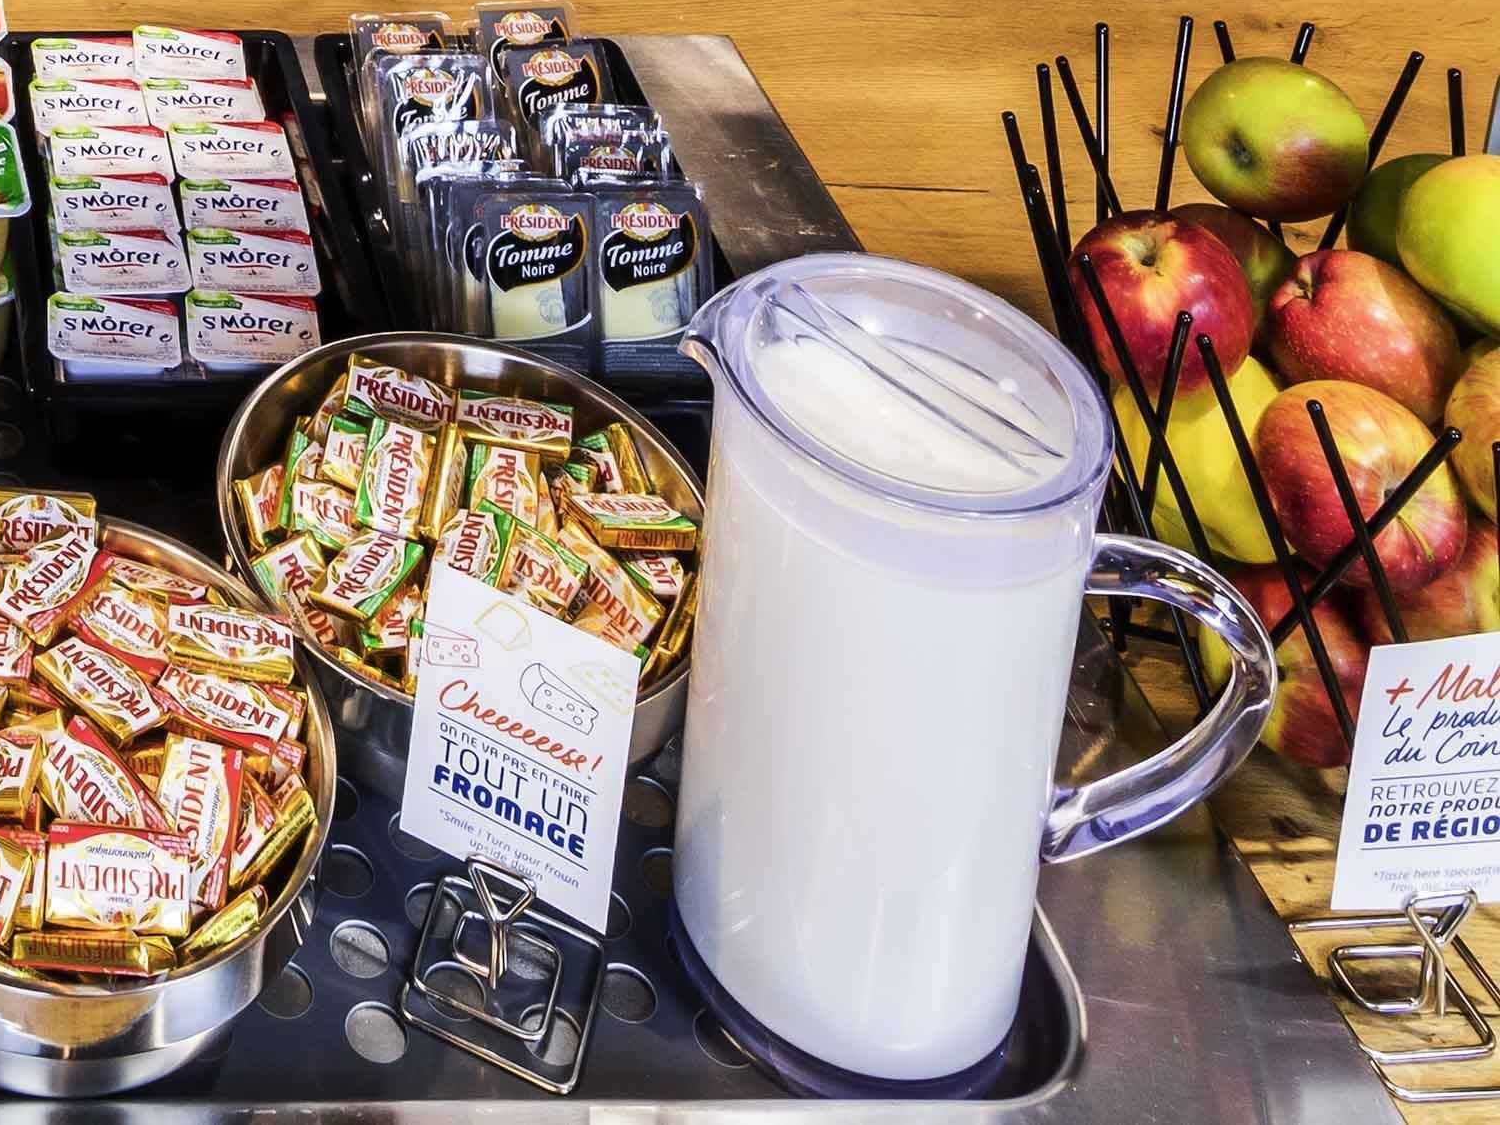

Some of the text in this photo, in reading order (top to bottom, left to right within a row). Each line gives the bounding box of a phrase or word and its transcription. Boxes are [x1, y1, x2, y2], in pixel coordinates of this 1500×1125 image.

[523, 58, 582, 75] PRÉSIDENT
[524, 82, 589, 114] Tomme
[501, 212, 570, 229] PRÉSIDENT
[612, 212, 680, 228] PRÉSIDENT
[496, 243, 573, 267] Tomme
[607, 241, 684, 267] Tomme
[633, 262, 667, 277] Noire
[522, 264, 555, 277] Noire
[356, 375, 452, 422] PRÉSIDENT
[465, 404, 571, 433] PRÉSIDENT
[6, 538, 88, 611] PRÉSIDENT
[179, 612, 291, 649] PRÉSIDENT
[59, 642, 150, 719] PRÉSIDENT
[1417, 663, 1500, 709] Mal
[165, 667, 279, 728] PRÉSIDENT
[1424, 700, 1500, 740] produ
[440, 722, 590, 806] ON NE VA PAS EN FAIRE
[1384, 737, 1426, 765] du
[440, 735, 587, 834] TOUT UN
[1371, 778, 1499, 801] RETROUVEZ
[434, 764, 585, 859] FROMAGE
[1369, 796, 1500, 818] NOTRE PRODU
[1363, 815, 1500, 843] DE RÉGIO
[485, 832, 511, 851] Turn
[515, 848, 540, 867] your
[545, 862, 580, 888] frown
[60, 861, 184, 901] PRÉSIDENT
